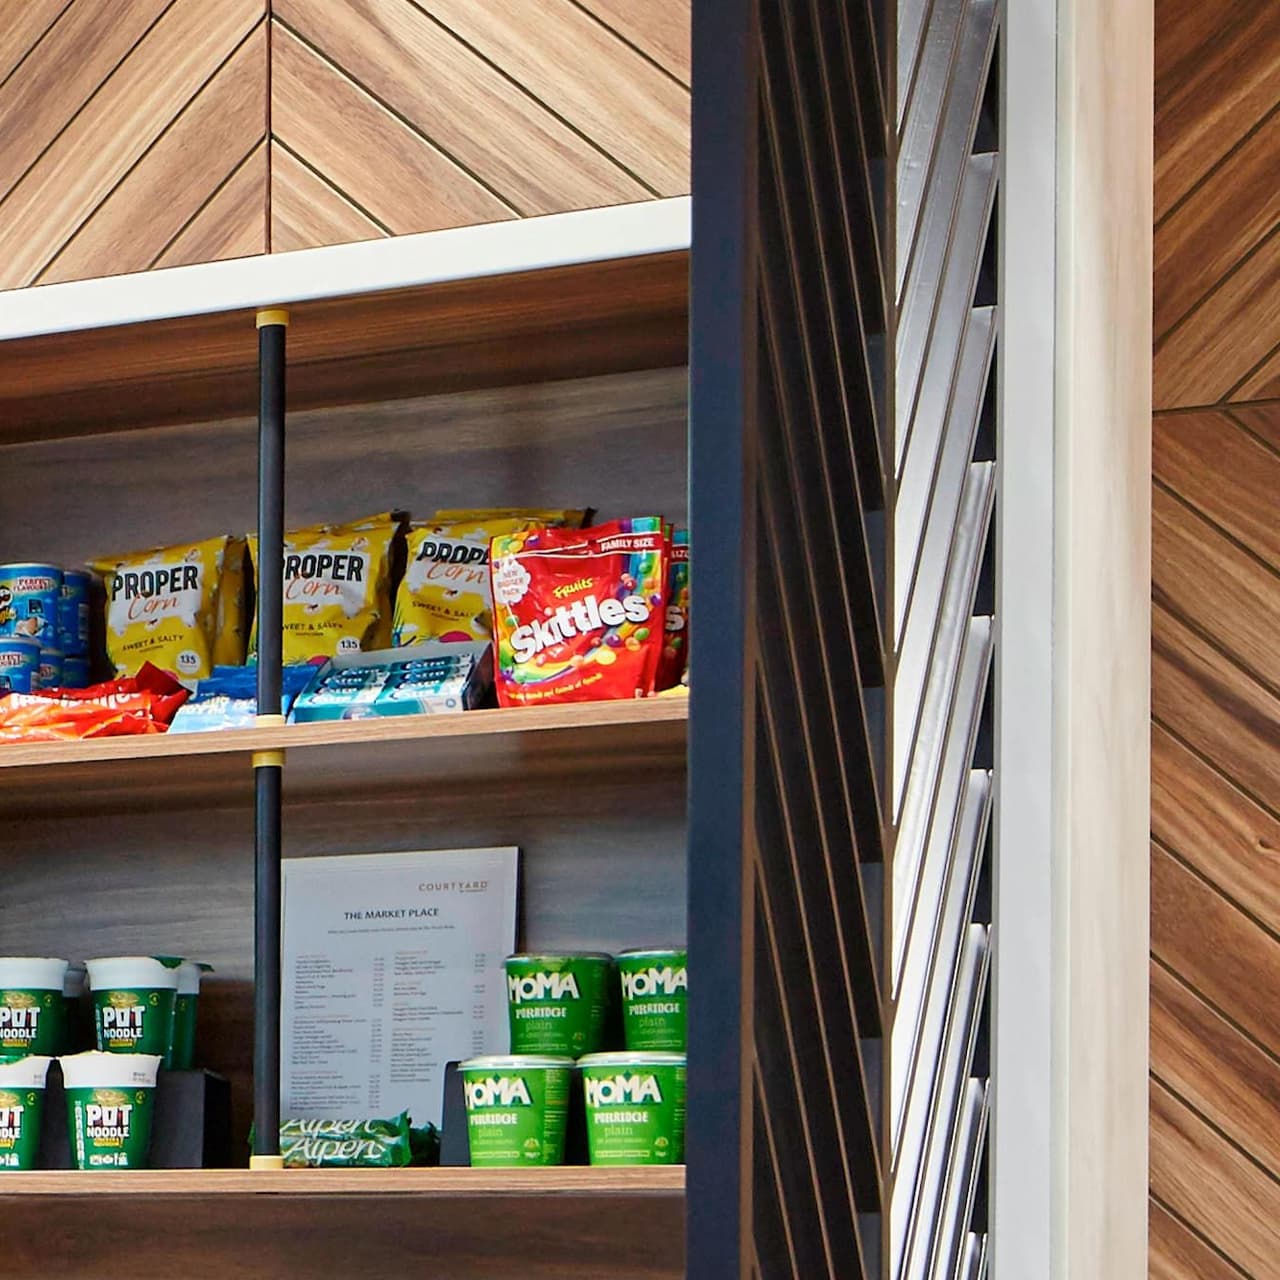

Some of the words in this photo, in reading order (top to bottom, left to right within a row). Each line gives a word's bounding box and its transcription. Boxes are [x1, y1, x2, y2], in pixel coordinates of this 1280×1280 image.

[601, 540, 632, 552] FAMILY
[633, 537, 654, 547] SIZE
[427, 560, 484, 584] Corn
[112, 565, 198, 601] PROPER
[285, 574, 343, 600] Corn
[553, 577, 593, 598] Fruits
[128, 593, 177, 620] Corn
[511, 595, 650, 663] Skittles
[122, 640, 149, 651] SWEET
[158, 633, 185, 643] SALTY
[341, 641, 358, 649] 135
[180, 653, 197, 664] 135
[418, 880, 489, 892] COURTYARD
[344, 911, 363, 920] THE
[364, 909, 406, 919] MARKET
[408, 907, 440, 917] PLACE
[103, 1005, 146, 1028] POT
[638, 1016, 667, 1030] plain
[103, 1027, 143, 1039] NOODLE
[525, 1019, 553, 1033] plain
[86, 1104, 133, 1126] POT
[86, 1126, 130, 1138] NOODLE
[478, 1127, 503, 1139] plain
[604, 1125, 633, 1138] plain
[282, 1137, 382, 1165] Alpen
